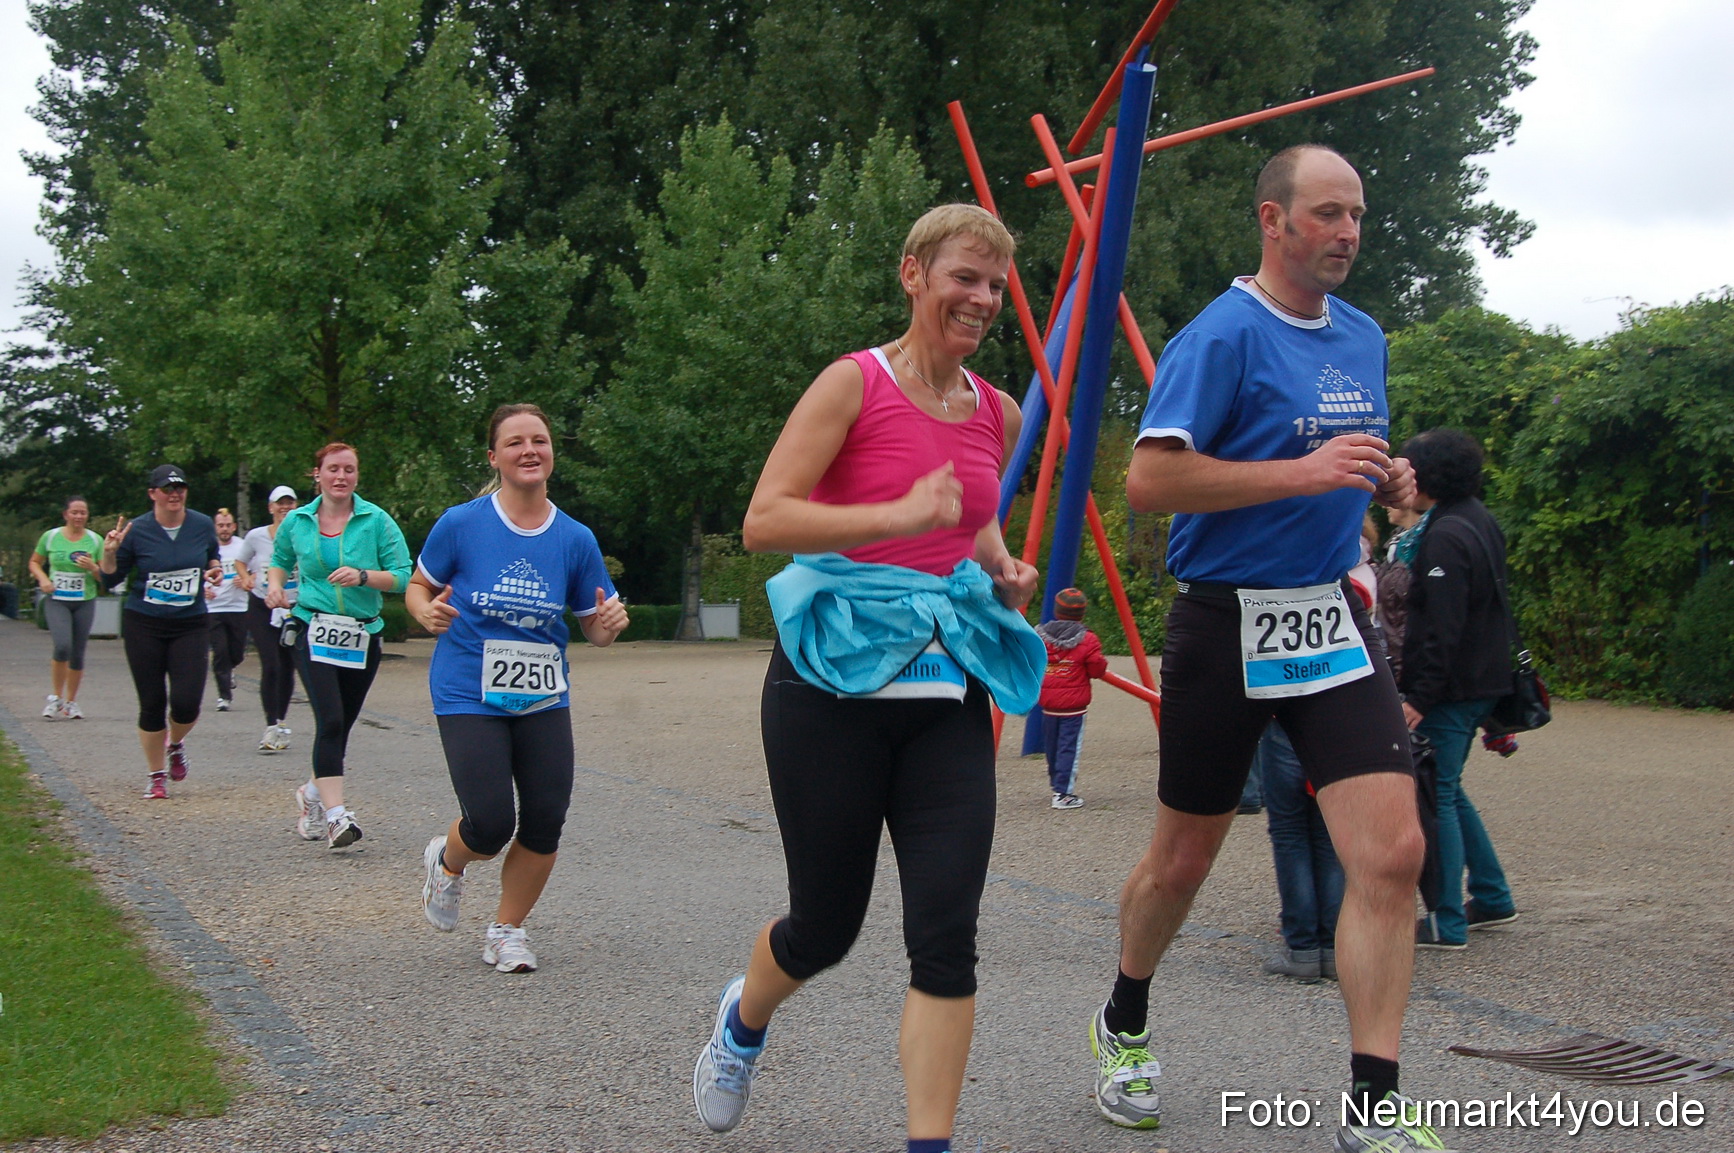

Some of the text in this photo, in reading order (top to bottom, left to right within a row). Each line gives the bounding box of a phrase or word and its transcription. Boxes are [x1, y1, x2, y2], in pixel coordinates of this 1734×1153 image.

[1293, 416, 1322, 436] 13.
[1319, 416, 1363, 426] Neumarkter
[471, 591, 494, 607] 13.
[315, 626, 362, 648] 2621
[1255, 606, 1350, 654] 2362
[486, 647, 551, 660] PARTL Neumarkt
[491, 660, 557, 691] 2250
[1283, 661, 1331, 680] Stefan
